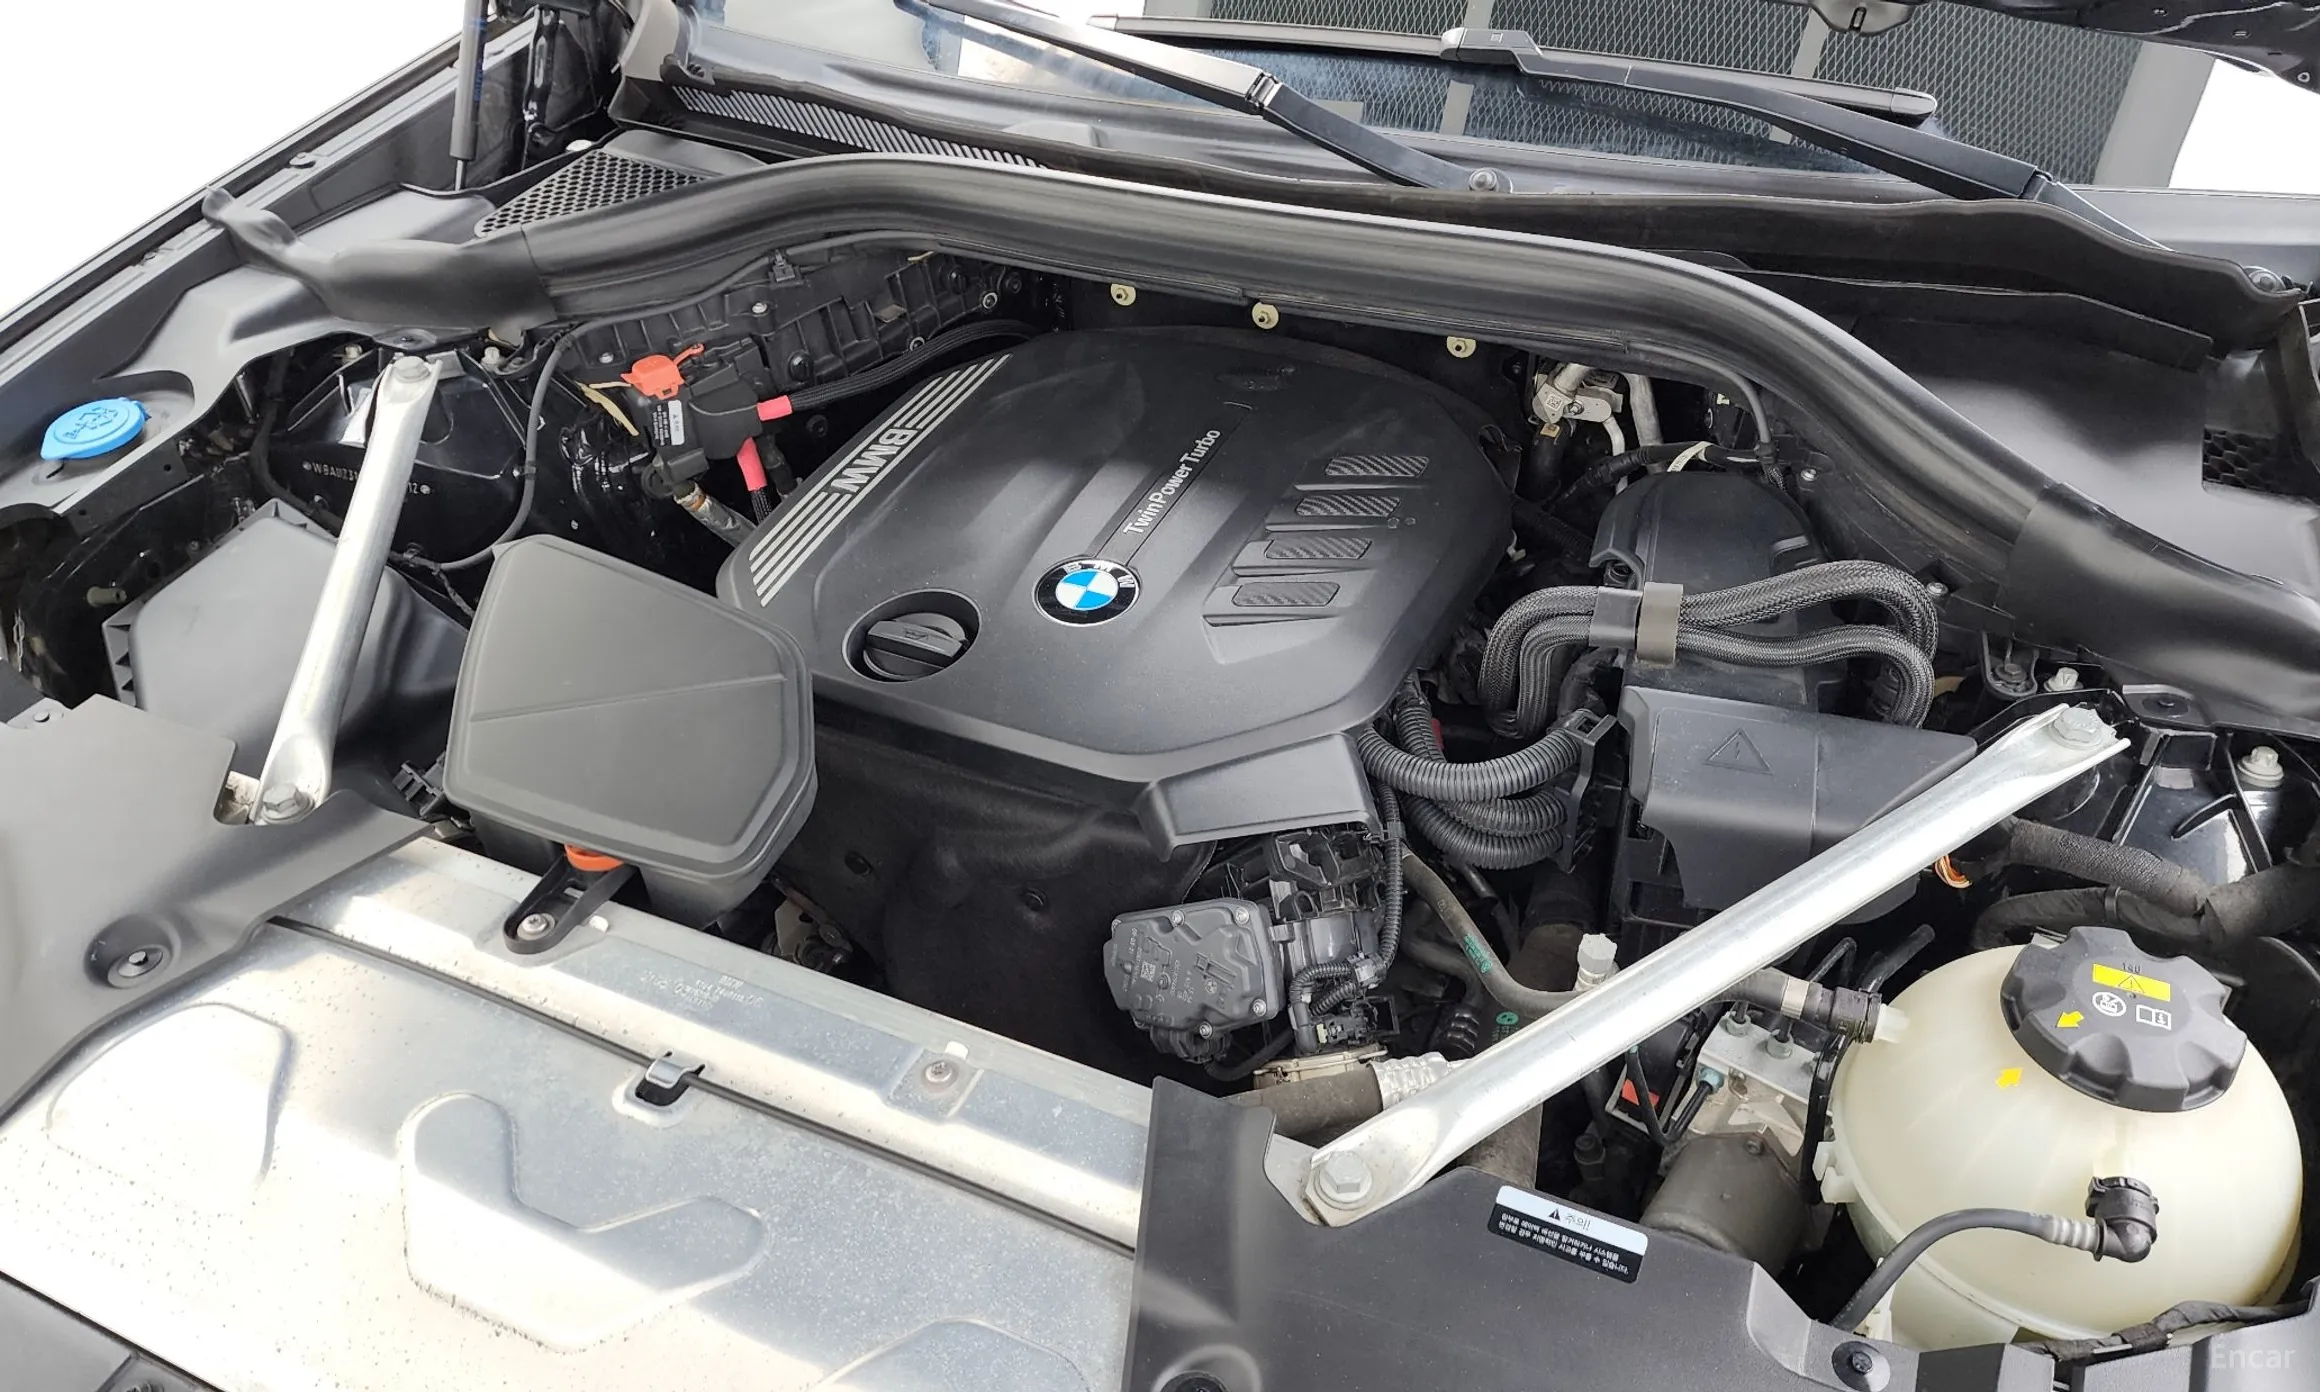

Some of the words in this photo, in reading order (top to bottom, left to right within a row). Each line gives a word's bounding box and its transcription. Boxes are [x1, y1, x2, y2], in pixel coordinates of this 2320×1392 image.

[830, 428, 918, 492] BMW
[1123, 463, 1193, 535] TwinPower
[1180, 429, 1221, 463] Turbo
[1063, 561, 1136, 588] BMW
